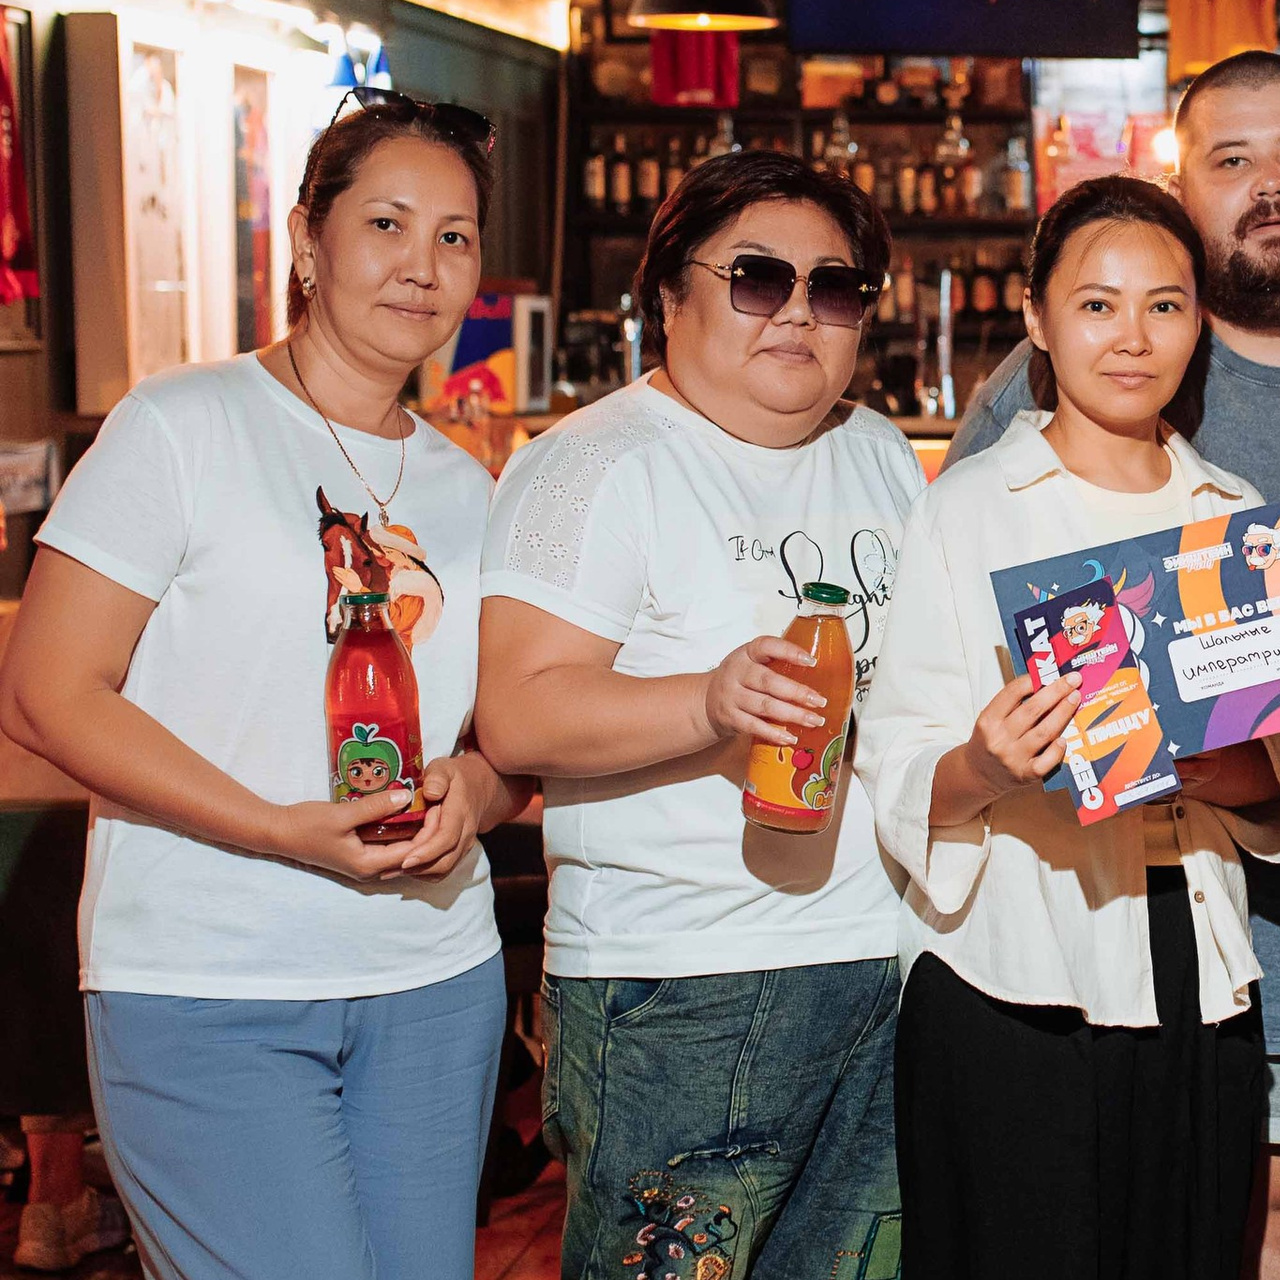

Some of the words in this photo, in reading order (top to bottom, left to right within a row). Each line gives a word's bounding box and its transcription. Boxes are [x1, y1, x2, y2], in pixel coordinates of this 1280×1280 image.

[1173, 619, 1203, 634] МЫ
[1205, 612, 1217, 627] В
[1218, 604, 1254, 623] ВАС
[1199, 625, 1272, 650] Шальные
[1087, 708, 1150, 746] ПИЦЦУ
